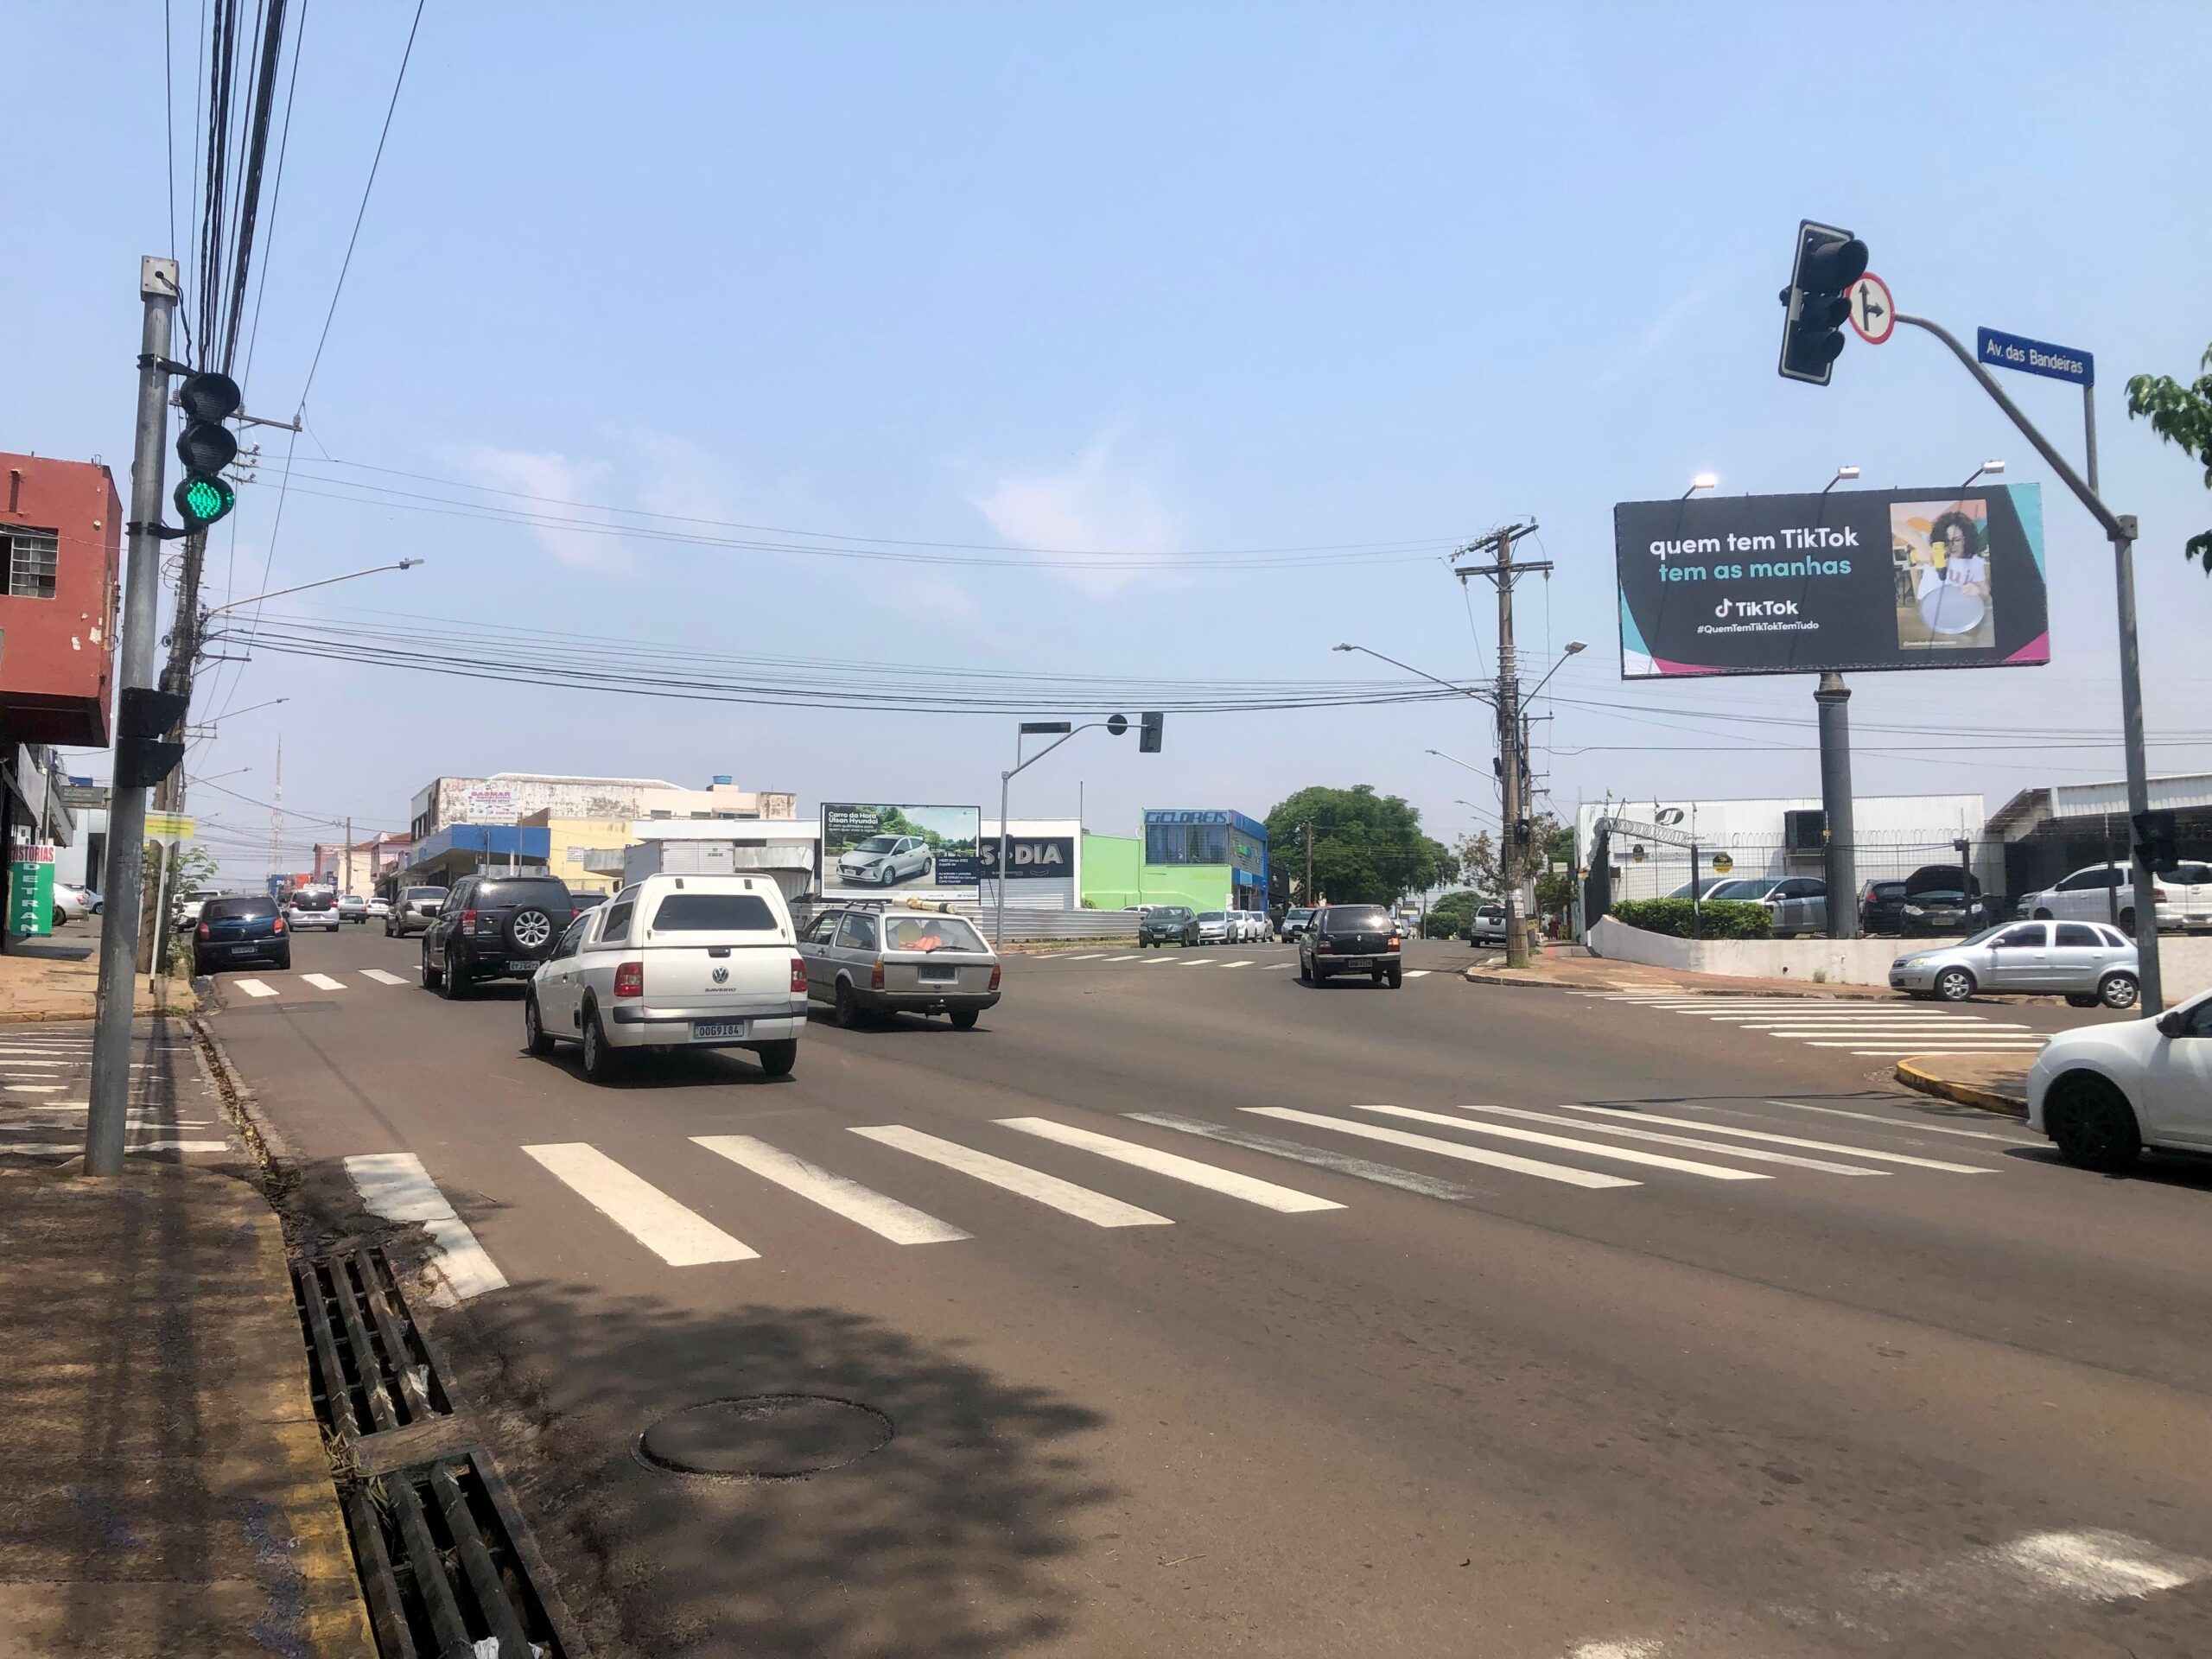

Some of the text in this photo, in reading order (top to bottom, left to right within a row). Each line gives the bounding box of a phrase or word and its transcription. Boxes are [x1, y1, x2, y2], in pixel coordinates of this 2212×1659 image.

[1986, 339, 2083, 374] Av. das Bandeiras
[1649, 526, 1859, 560] quem tem TikTok
[1658, 555, 1852, 582] tem as manhas
[1735, 600, 1799, 617] TikTok
[1697, 620, 1820, 634] #QuemTemTikTokTemTudo
[1014, 843, 1064, 865] DIA
[20, 862, 40, 932] DETRAN
